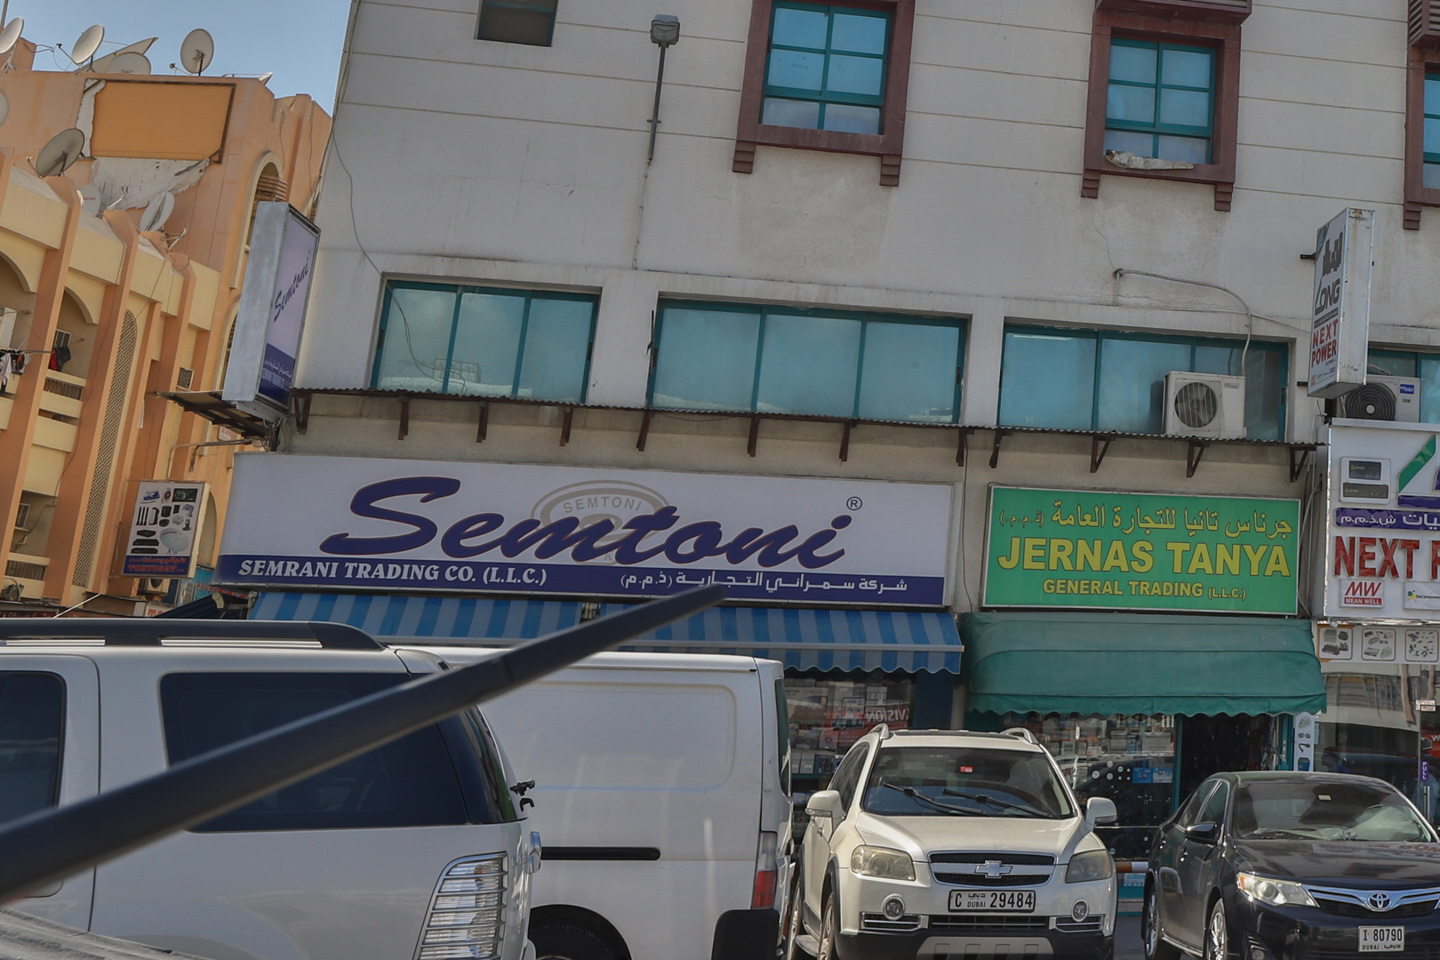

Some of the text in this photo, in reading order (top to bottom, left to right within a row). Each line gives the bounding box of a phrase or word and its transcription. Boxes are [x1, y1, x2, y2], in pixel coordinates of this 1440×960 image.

[1315, 278, 1341, 316] LONG
[1313, 319, 1338, 349] NEXT
[1311, 339, 1337, 368] POWER
[563, 496, 642, 513] SEMTONI
[1051, 500, 1105, 528] العامة
[319, 476, 847, 569] Semtoni
[1112, 505, 1175, 535] للتجارة
[1183, 508, 1219, 537] تانيا
[1225, 510, 1292, 541] جرناس
[997, 536, 1291, 577] JERNAS TANYA
[1334, 536, 1420, 579] NEXT
[238, 559, 547, 586] SEMRANI TRADING CO. (L.L.C.)
[676, 571, 763, 588] التجارية
[766, 573, 855, 593] سمراني
[858, 578, 907, 594] شركة
[1043, 579, 1123, 596] GENERAL
[1129, 580, 1203, 597] TRADING
[1345, 581, 1382, 596] MW
[955, 893, 962, 907] C
[990, 893, 1033, 908] 29484
[1373, 929, 1402, 941] 80790
